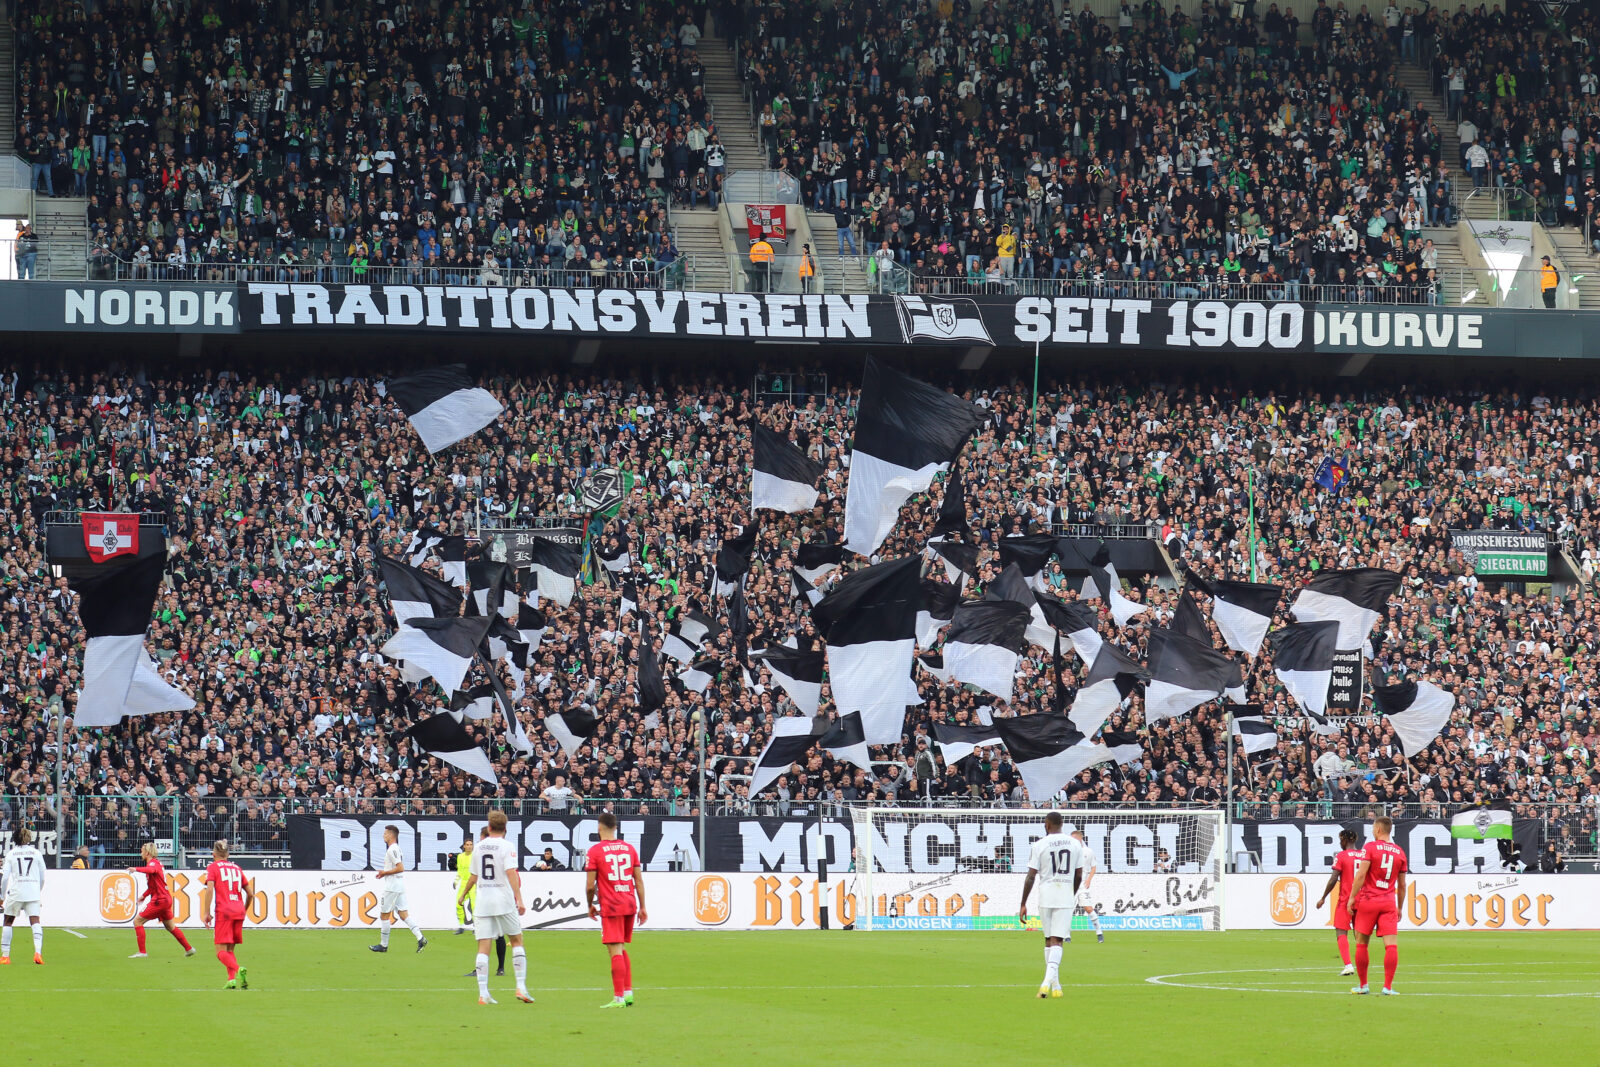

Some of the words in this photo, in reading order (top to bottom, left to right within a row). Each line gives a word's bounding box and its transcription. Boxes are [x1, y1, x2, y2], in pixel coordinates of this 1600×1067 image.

[64, 289, 243, 326] NORDK
[247, 283, 871, 339] TRADITIONSVEREIN
[1014, 297, 1151, 344] SEIT
[1166, 302, 1304, 348] 1900
[1481, 558, 1546, 572] SIEGERLAND
[1332, 652, 1360, 662] emand
[1333, 666, 1354, 674] muss
[1333, 690, 1350, 702] sein
[16, 857, 34, 876] 17
[482, 854, 495, 880] 6
[604, 854, 632, 881] 32
[1050, 848, 1071, 876] 10
[1380, 854, 1394, 880] 4
[220, 867, 242, 892] 44
[531, 891, 580, 912] ein
[887, 918, 952, 929] JONGEN
[1118, 918, 1182, 929] JONGEN
